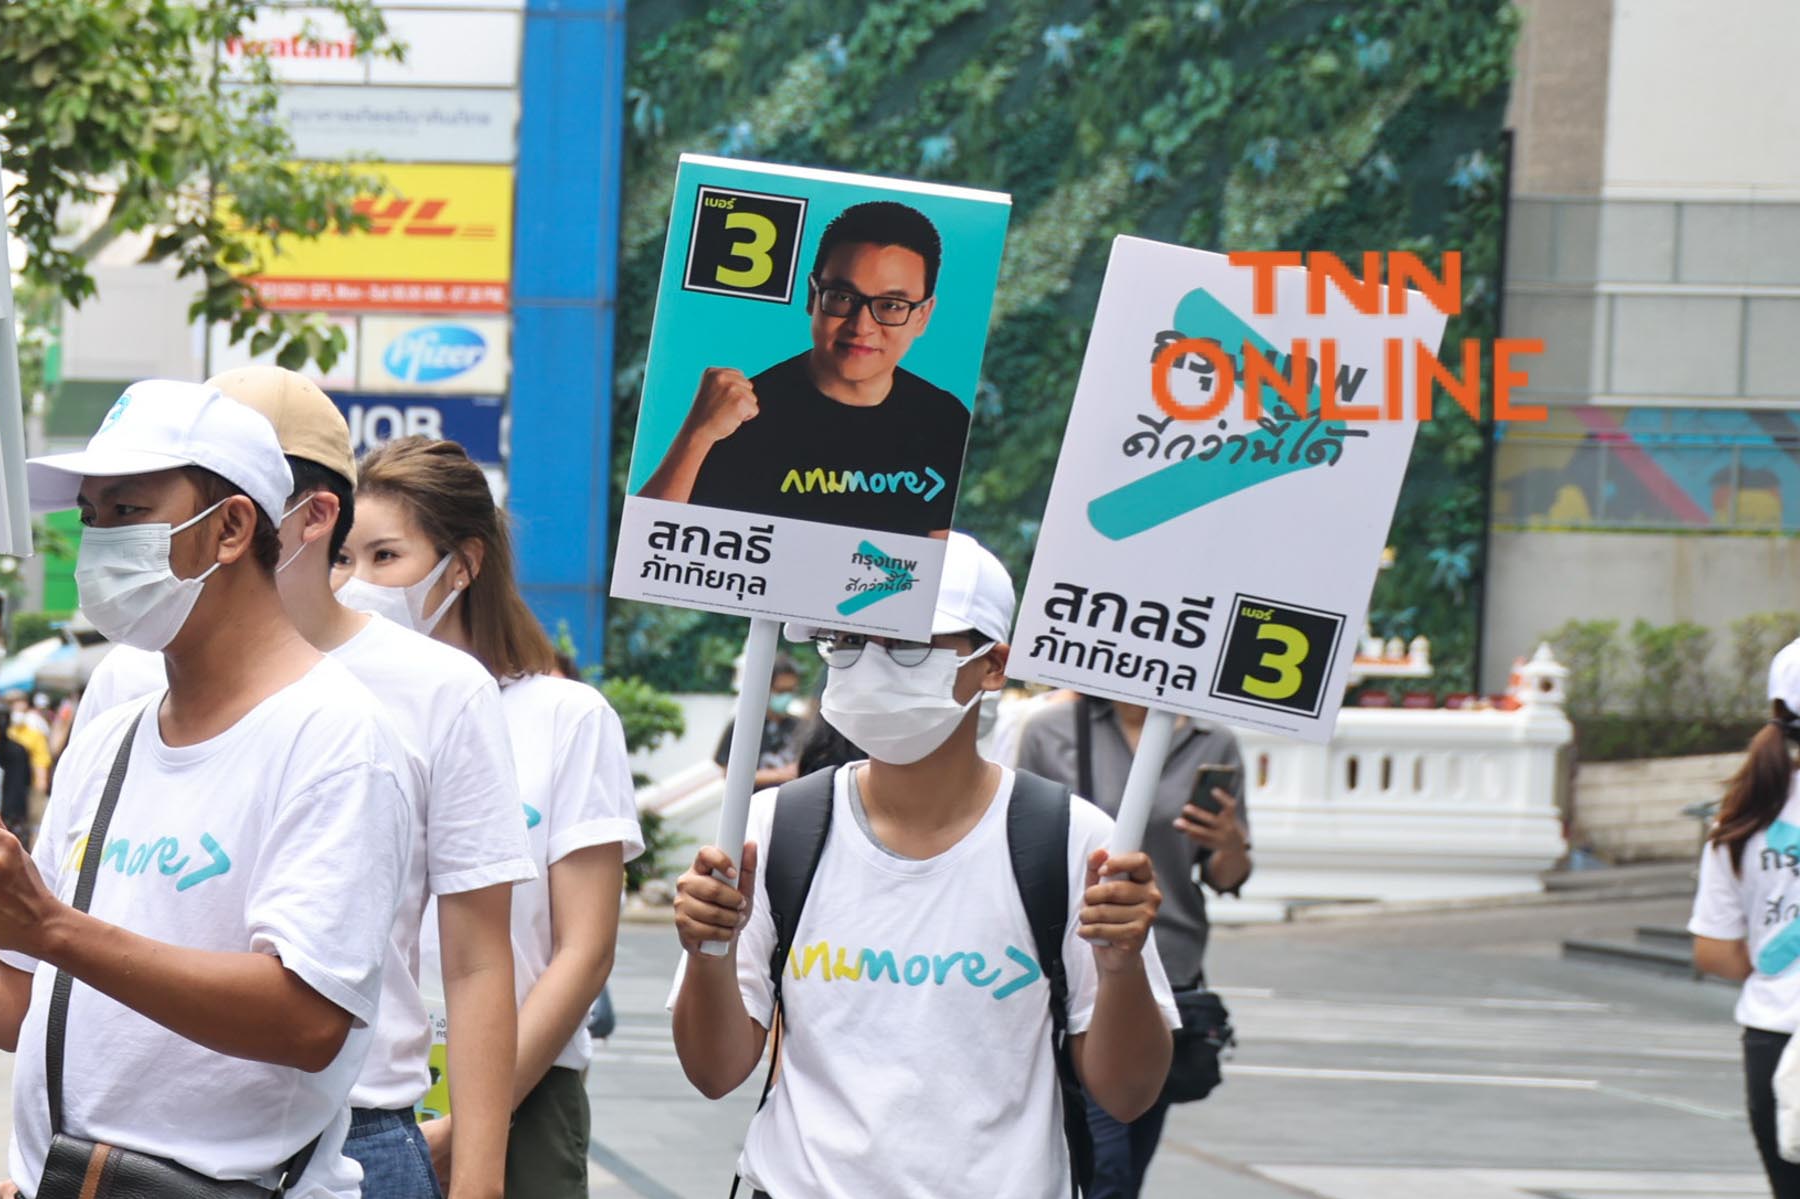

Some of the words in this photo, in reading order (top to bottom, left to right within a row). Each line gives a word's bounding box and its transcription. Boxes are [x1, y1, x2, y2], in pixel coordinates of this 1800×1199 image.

[704, 196, 736, 211] เบอร์
[714, 212, 779, 290] 3
[390, 328, 485, 383] Pfizer
[348, 405, 443, 450] JOB
[648, 518, 775, 566] สกลธี
[851, 552, 918, 571] กรุงเทพ
[639, 552, 768, 600] ภัททิยกุล
[1043, 580, 1215, 649] สกลธี
[1240, 605, 1274, 622] เบอร์
[1029, 625, 1198, 698] ภัททิยกุล
[1241, 623, 1311, 700] 3
